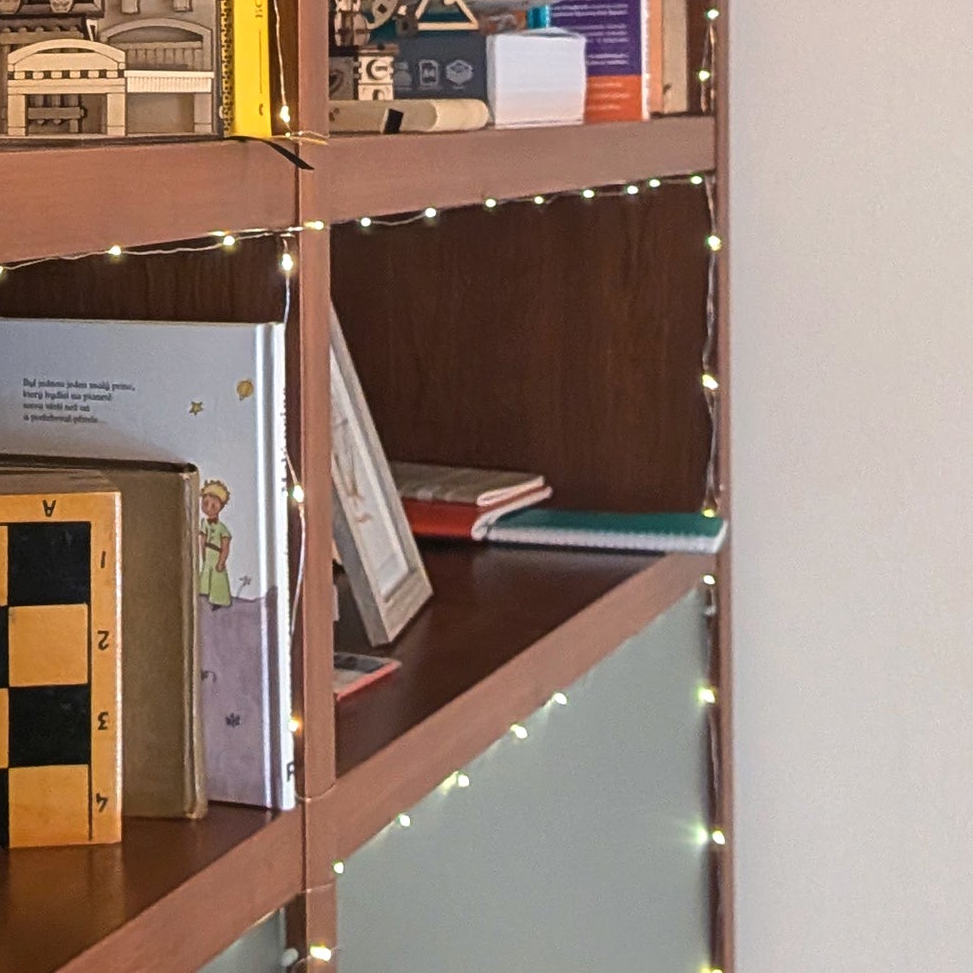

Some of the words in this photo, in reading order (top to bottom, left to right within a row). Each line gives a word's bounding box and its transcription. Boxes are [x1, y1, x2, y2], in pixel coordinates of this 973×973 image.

[42, 499, 57, 517] A
[97, 630, 109, 651] 2
[97, 711, 109, 731] 3
